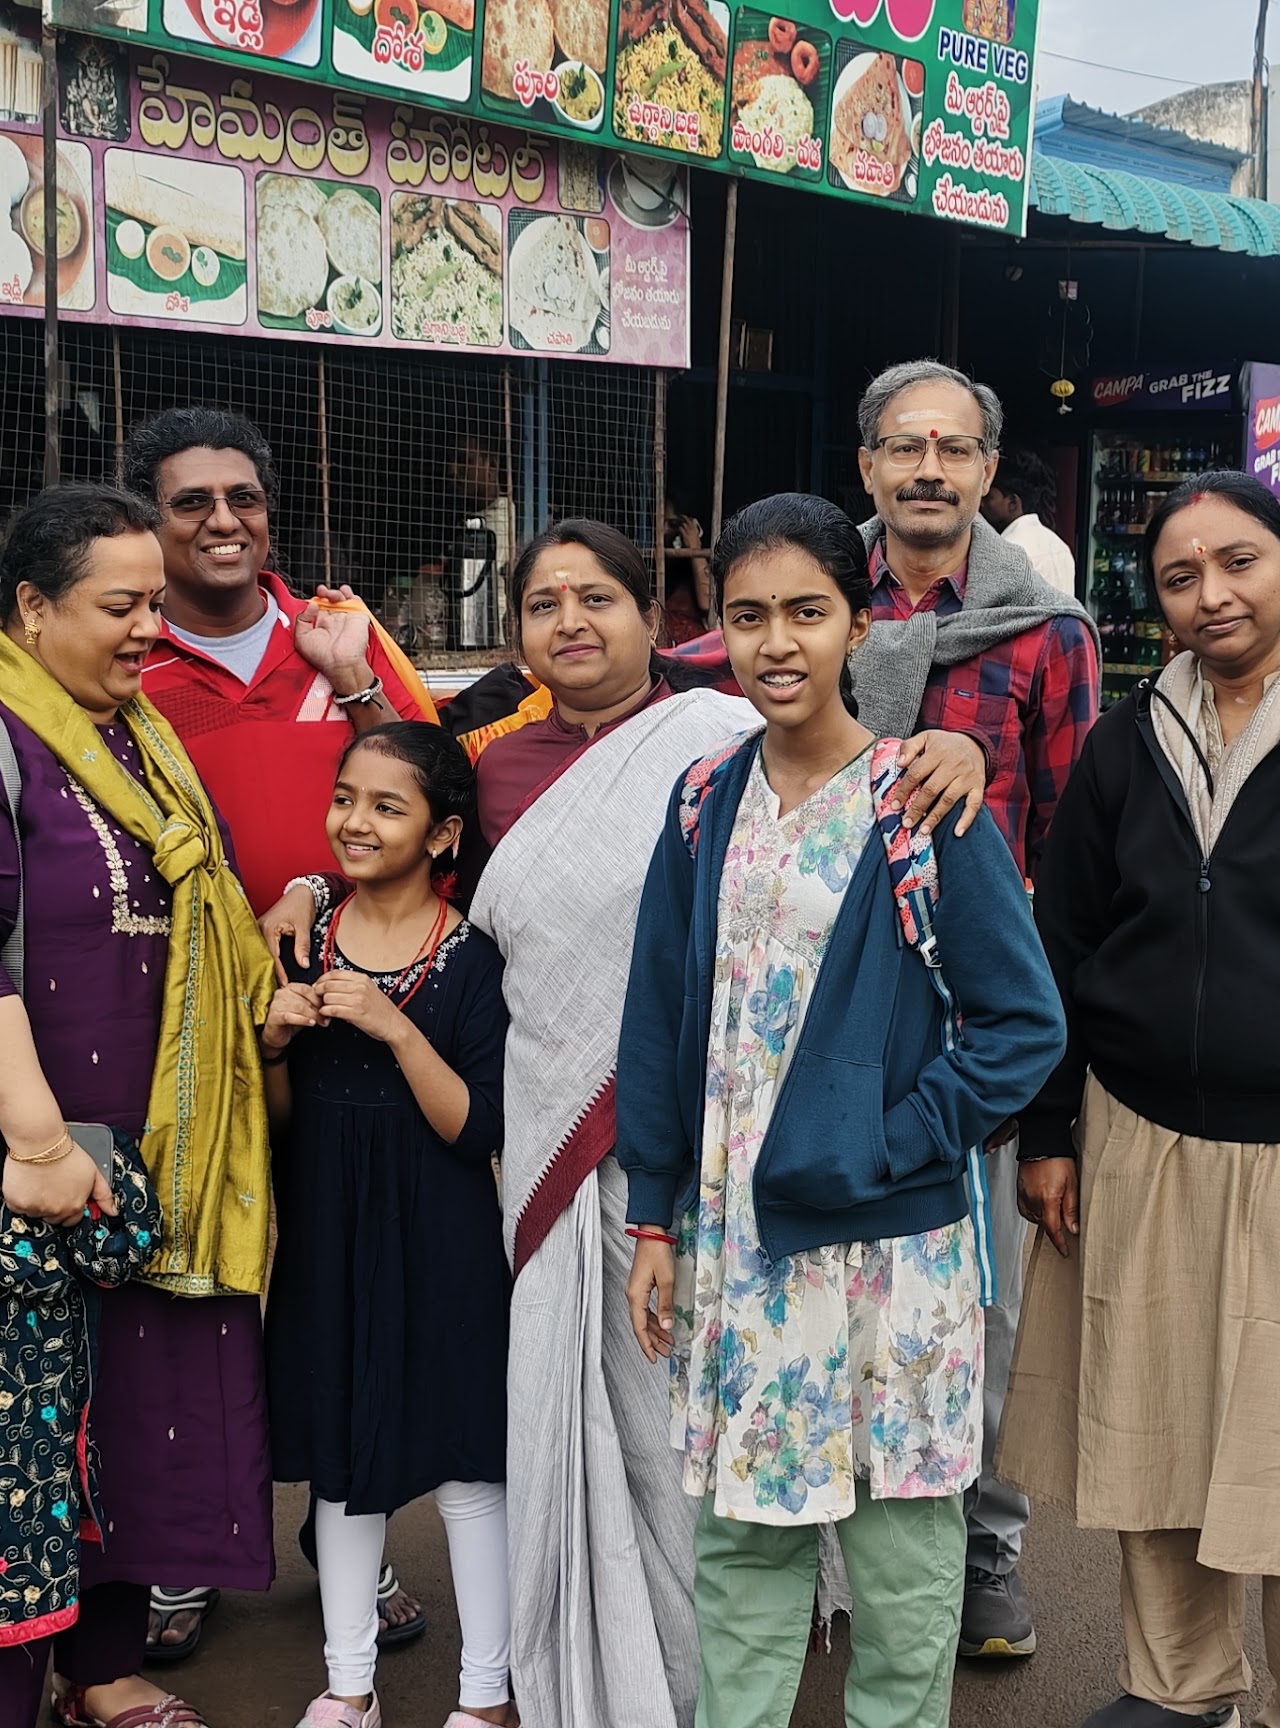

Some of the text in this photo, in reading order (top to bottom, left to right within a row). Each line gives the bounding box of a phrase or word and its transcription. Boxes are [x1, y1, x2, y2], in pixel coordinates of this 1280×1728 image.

[939, 29, 1029, 81] PURE VEG
[1093, 373, 1145, 400] CAMPA
[1148, 369, 1214, 394] GRAB THE
[1180, 373, 1231, 403] FIZZ
[1254, 450, 1277, 474] GRAB
